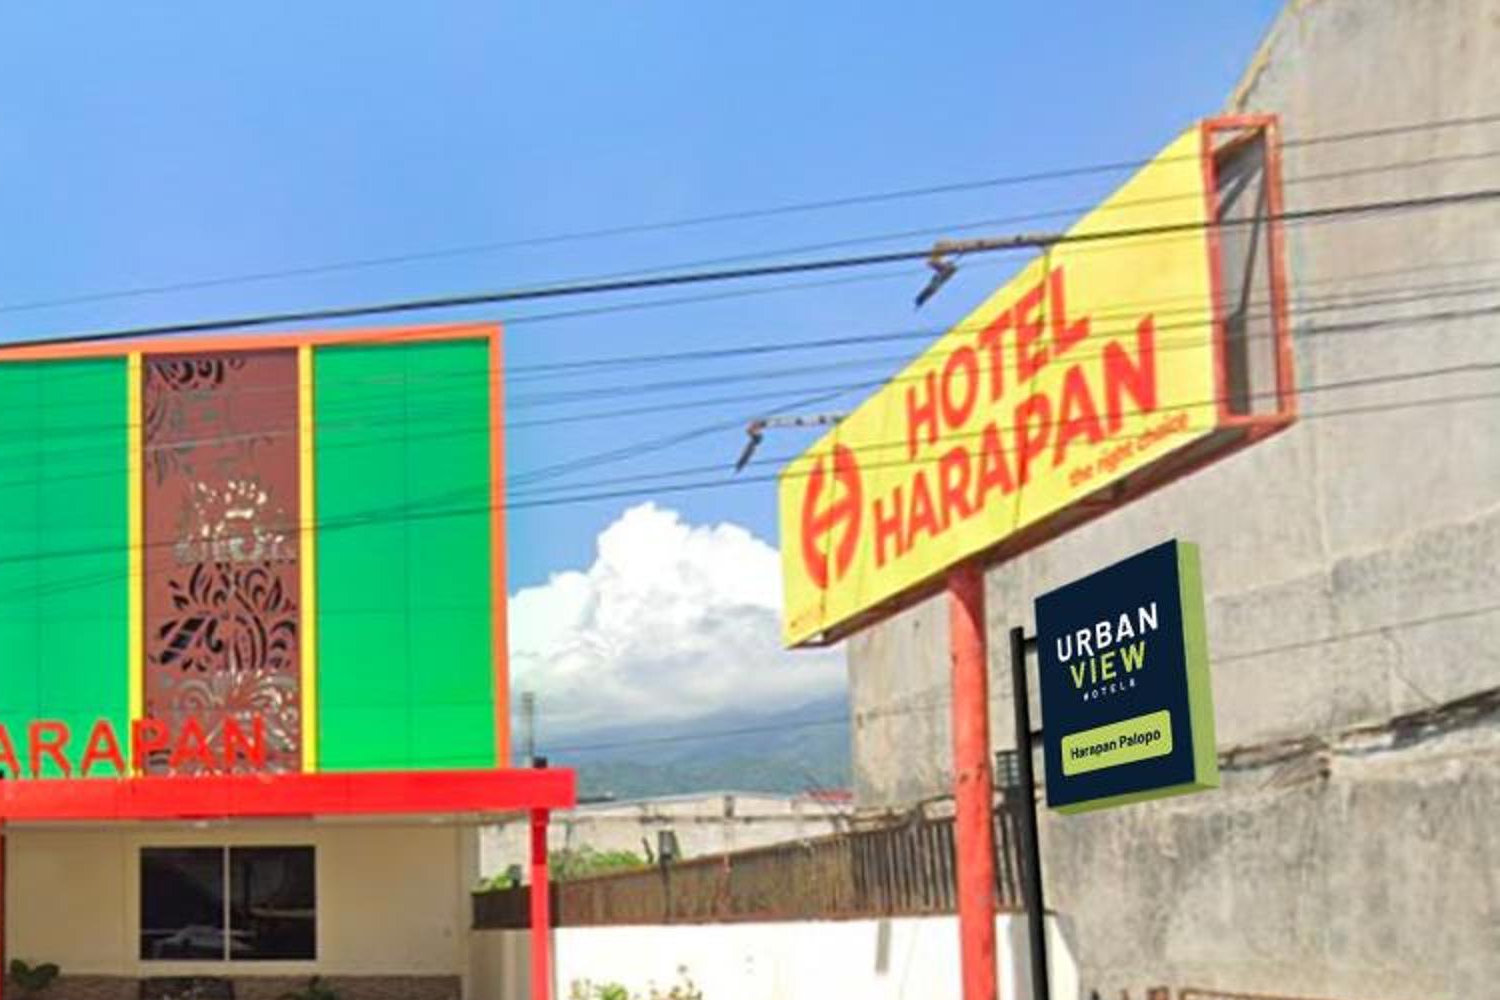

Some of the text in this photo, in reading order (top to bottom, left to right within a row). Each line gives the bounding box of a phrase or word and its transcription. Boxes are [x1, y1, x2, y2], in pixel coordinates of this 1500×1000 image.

[905, 264, 1091, 460] HOTEL
[873, 313, 1157, 569] HARAPAN
[1056, 601, 1160, 662] URBAN
[1069, 639, 1147, 690] VIEW
[1070, 728, 1162, 761] Harapan Palopo
